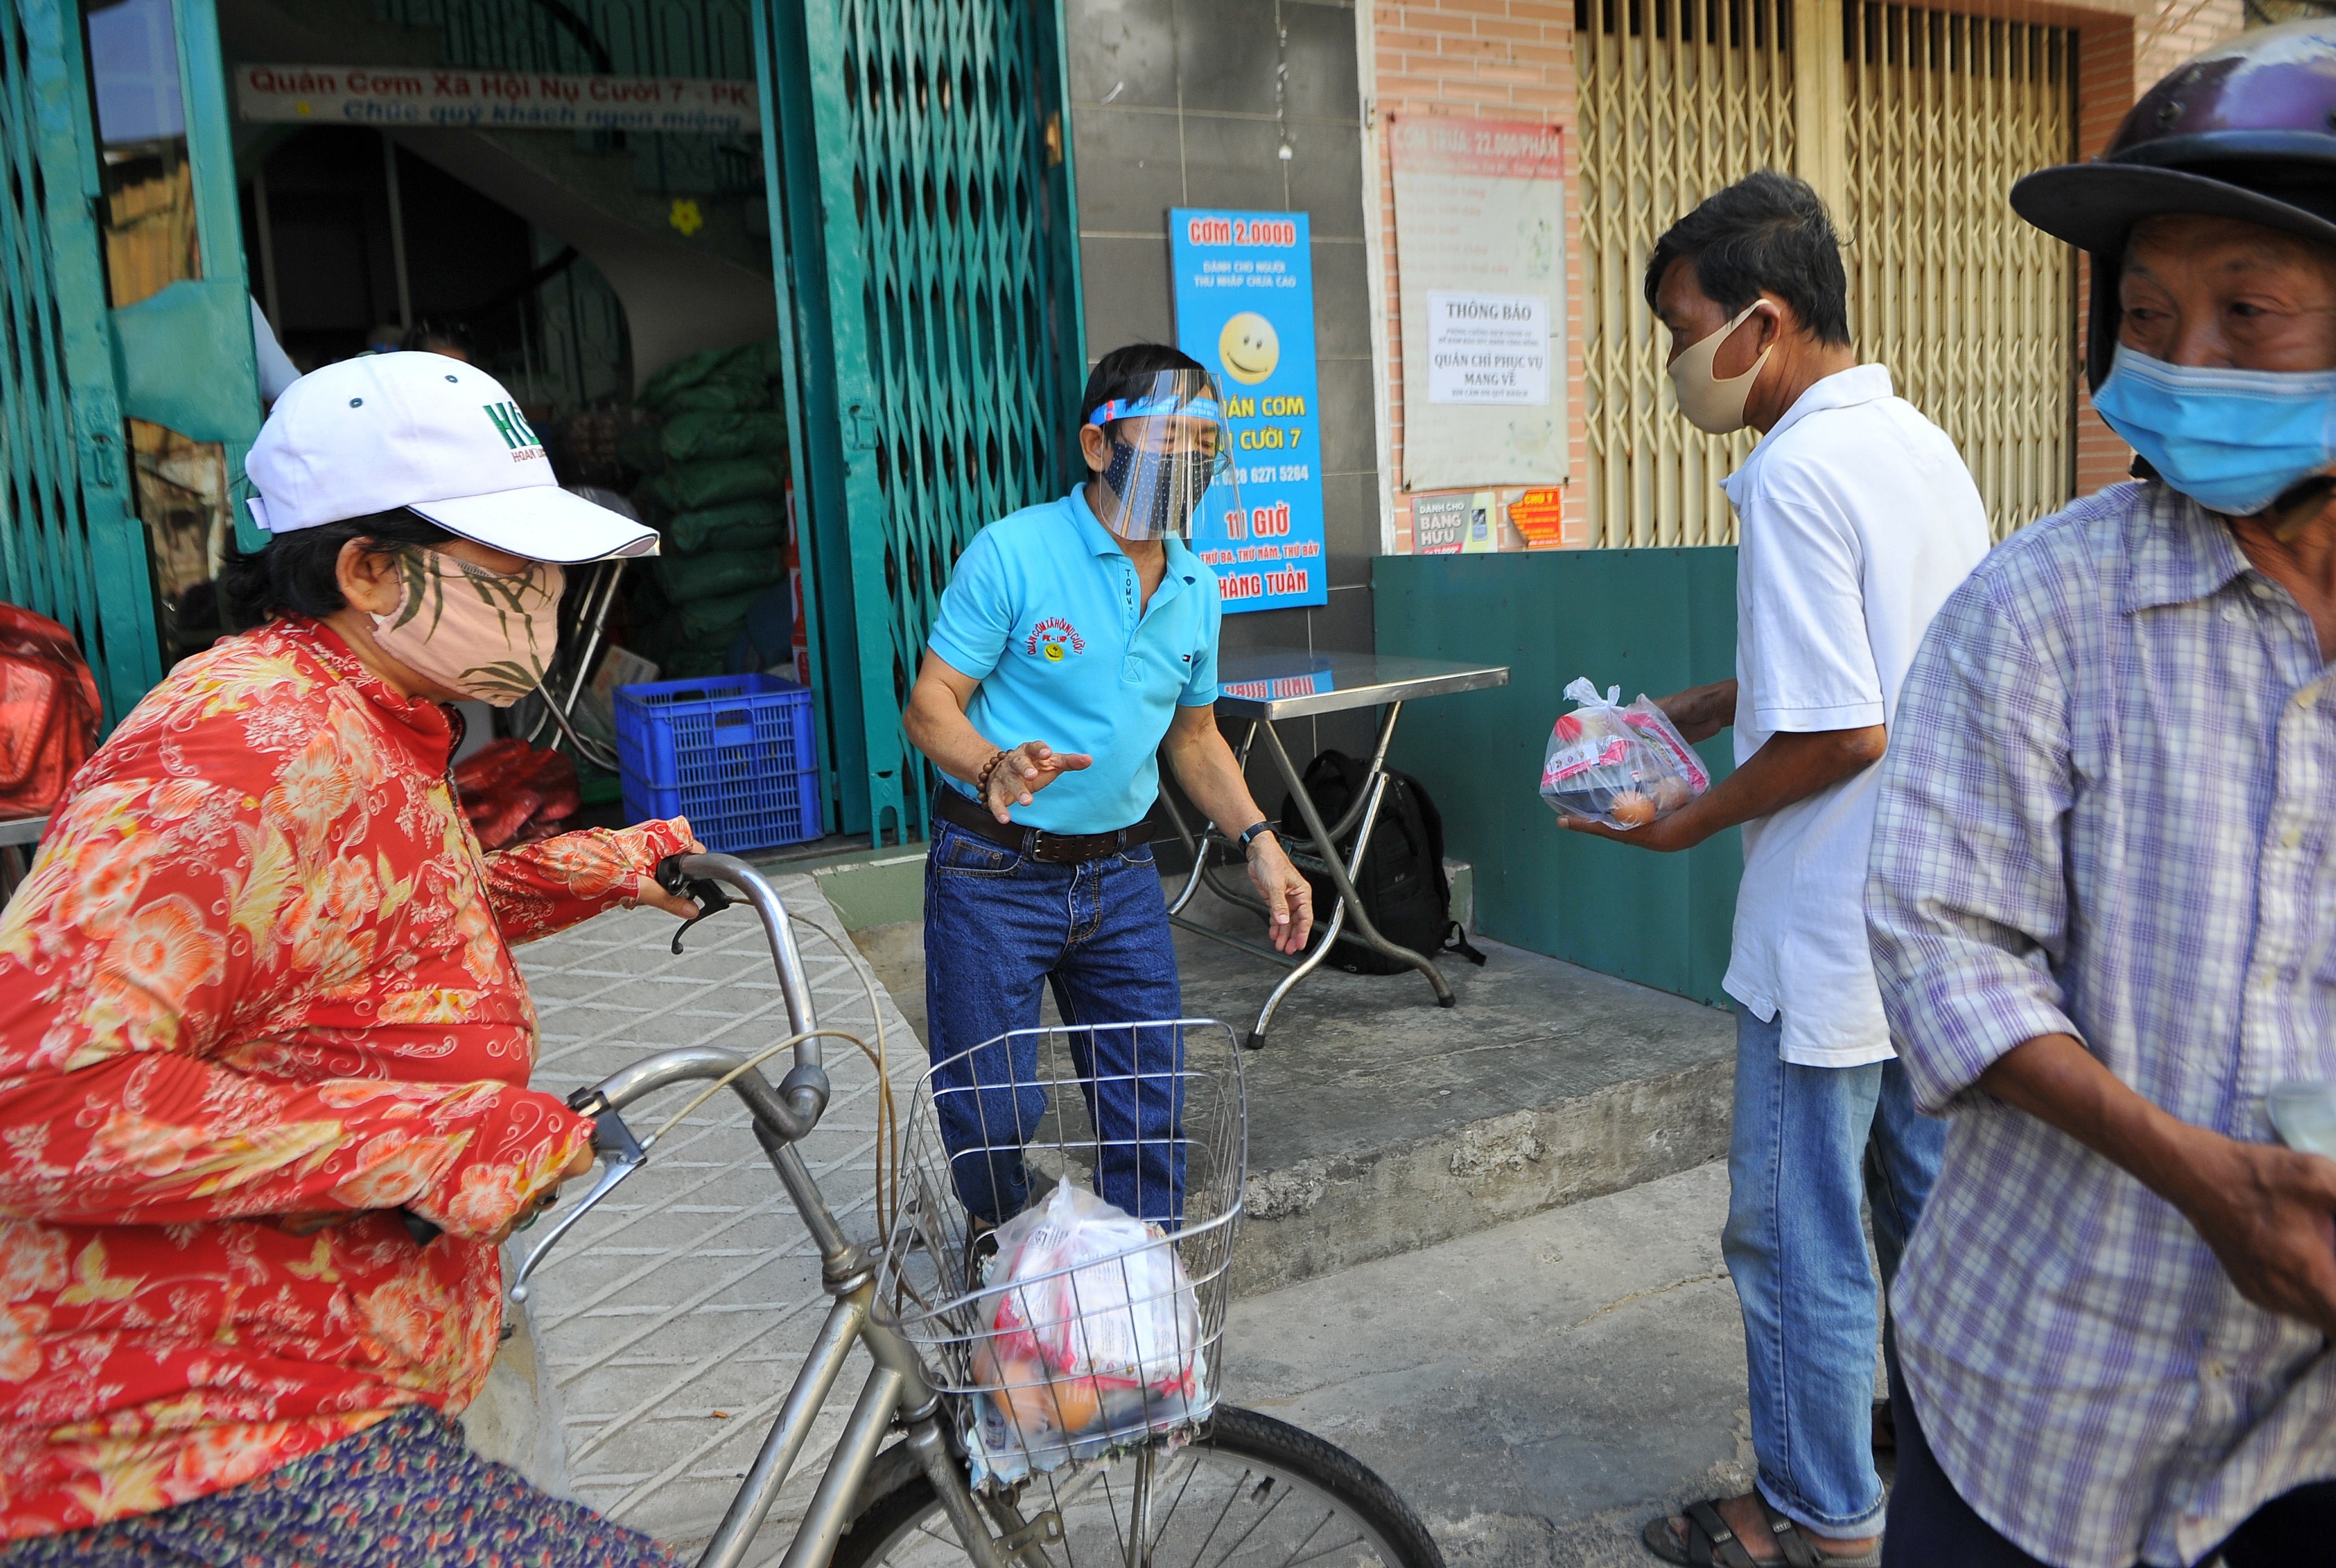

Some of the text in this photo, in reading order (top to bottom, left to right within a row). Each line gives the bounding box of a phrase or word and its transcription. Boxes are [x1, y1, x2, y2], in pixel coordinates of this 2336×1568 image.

[249, 66, 337, 94] Quán
[346, 68, 422, 96] Cơm
[431, 71, 472, 98] Xã
[481, 72, 530, 104] Hội
[540, 77, 579, 105] Nụ
[588, 77, 661, 103] Cười
[670, 81, 683, 103] 7
[343, 97, 419, 121] Chúc
[429, 100, 482, 125] quý
[493, 102, 576, 123] khách
[586, 110, 653, 131] ngon
[1189, 218, 1230, 245] CƠM
[1234, 260, 1254, 273] CHO
[1195, 275, 1214, 288] THU
[1275, 275, 1297, 288] CAO
[1503, 301, 1532, 321] BÁO
[1435, 352, 1468, 369] QUÁN
[1528, 356, 1544, 371] VỤ
[1465, 373, 1498, 386] MANG
[1223, 394, 1255, 418] ÁN
[1261, 395, 1306, 417] CƠM
[1240, 425, 1284, 450] CƯỜI
[1289, 428, 1302, 448] 7
[1250, 465, 1276, 484] 6271
[1419, 502, 1465, 515] DÀNH CHO
[1253, 502, 1291, 538] GIỜ
[1200, 550, 1218, 564] THỨ
[1238, 546, 1256, 562] THỨ
[1283, 543, 1300, 558] THỨ
[1218, 563, 1308, 599] HÀNG TUẦN
